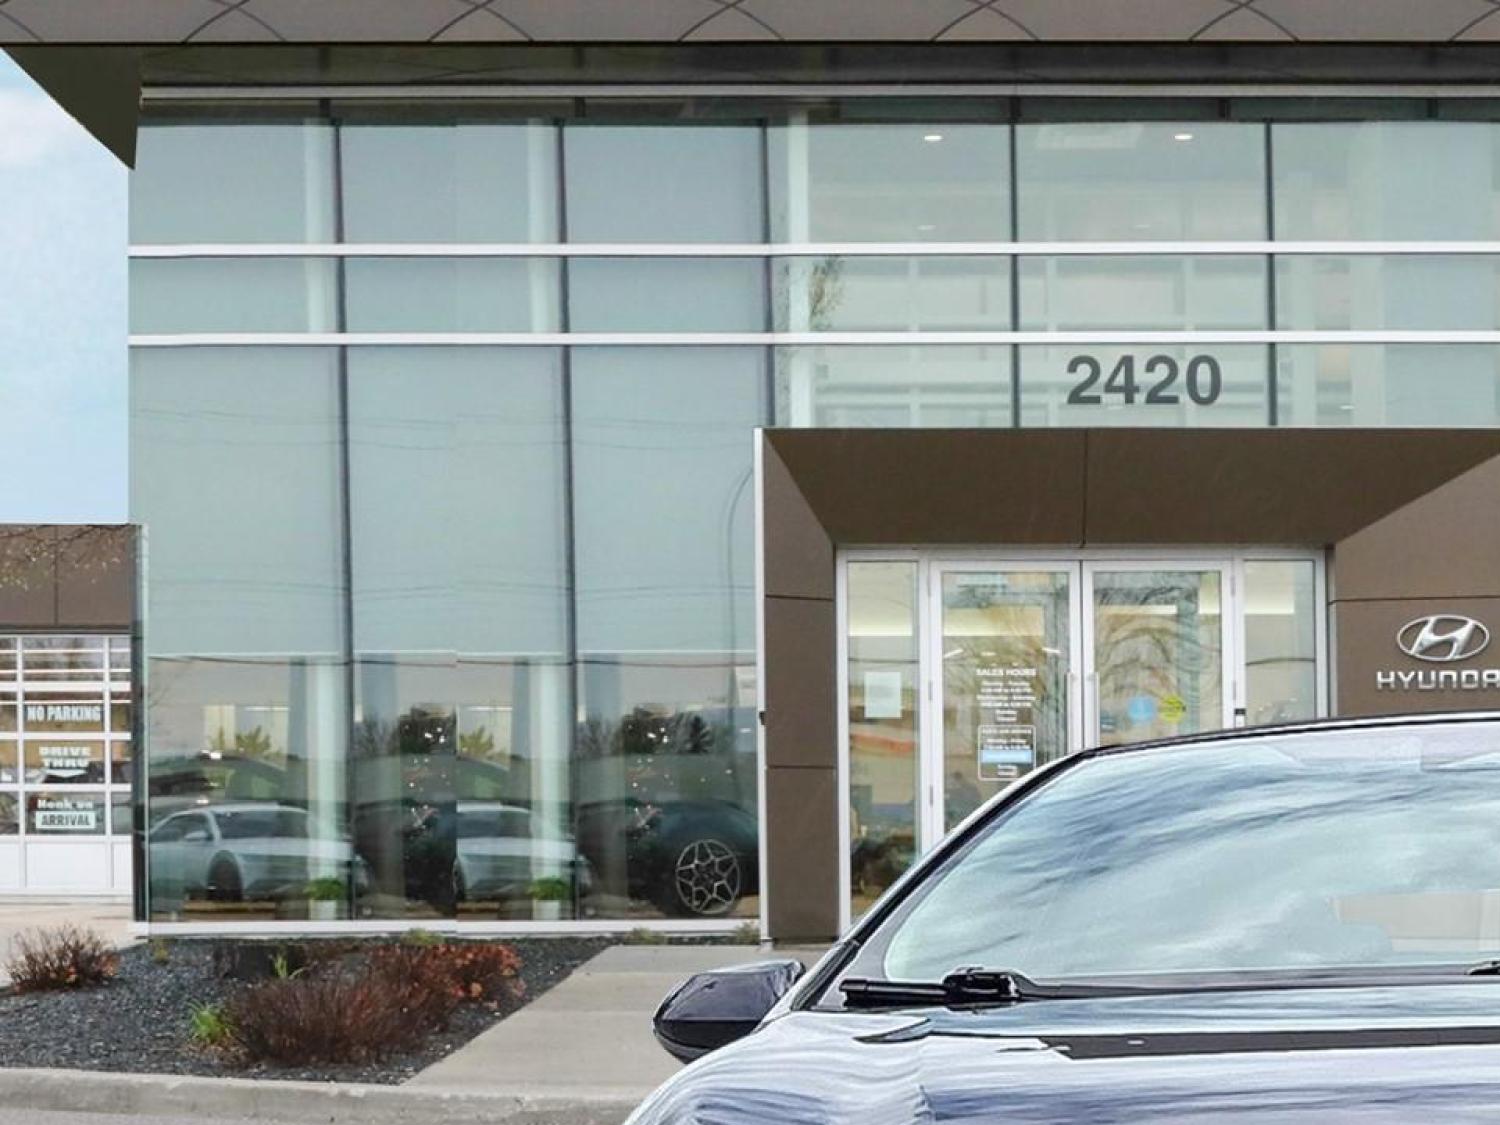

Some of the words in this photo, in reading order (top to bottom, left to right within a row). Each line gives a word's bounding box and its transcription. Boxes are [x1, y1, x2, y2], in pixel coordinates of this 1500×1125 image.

[1066, 354, 1222, 406] 2420
[27, 706, 45, 721] NO
[47, 706, 101, 721] PARKING
[39, 746, 91, 756] DRIVE
[43, 758, 89, 768] THRU
[41, 814, 91, 826] ARRIVAL
